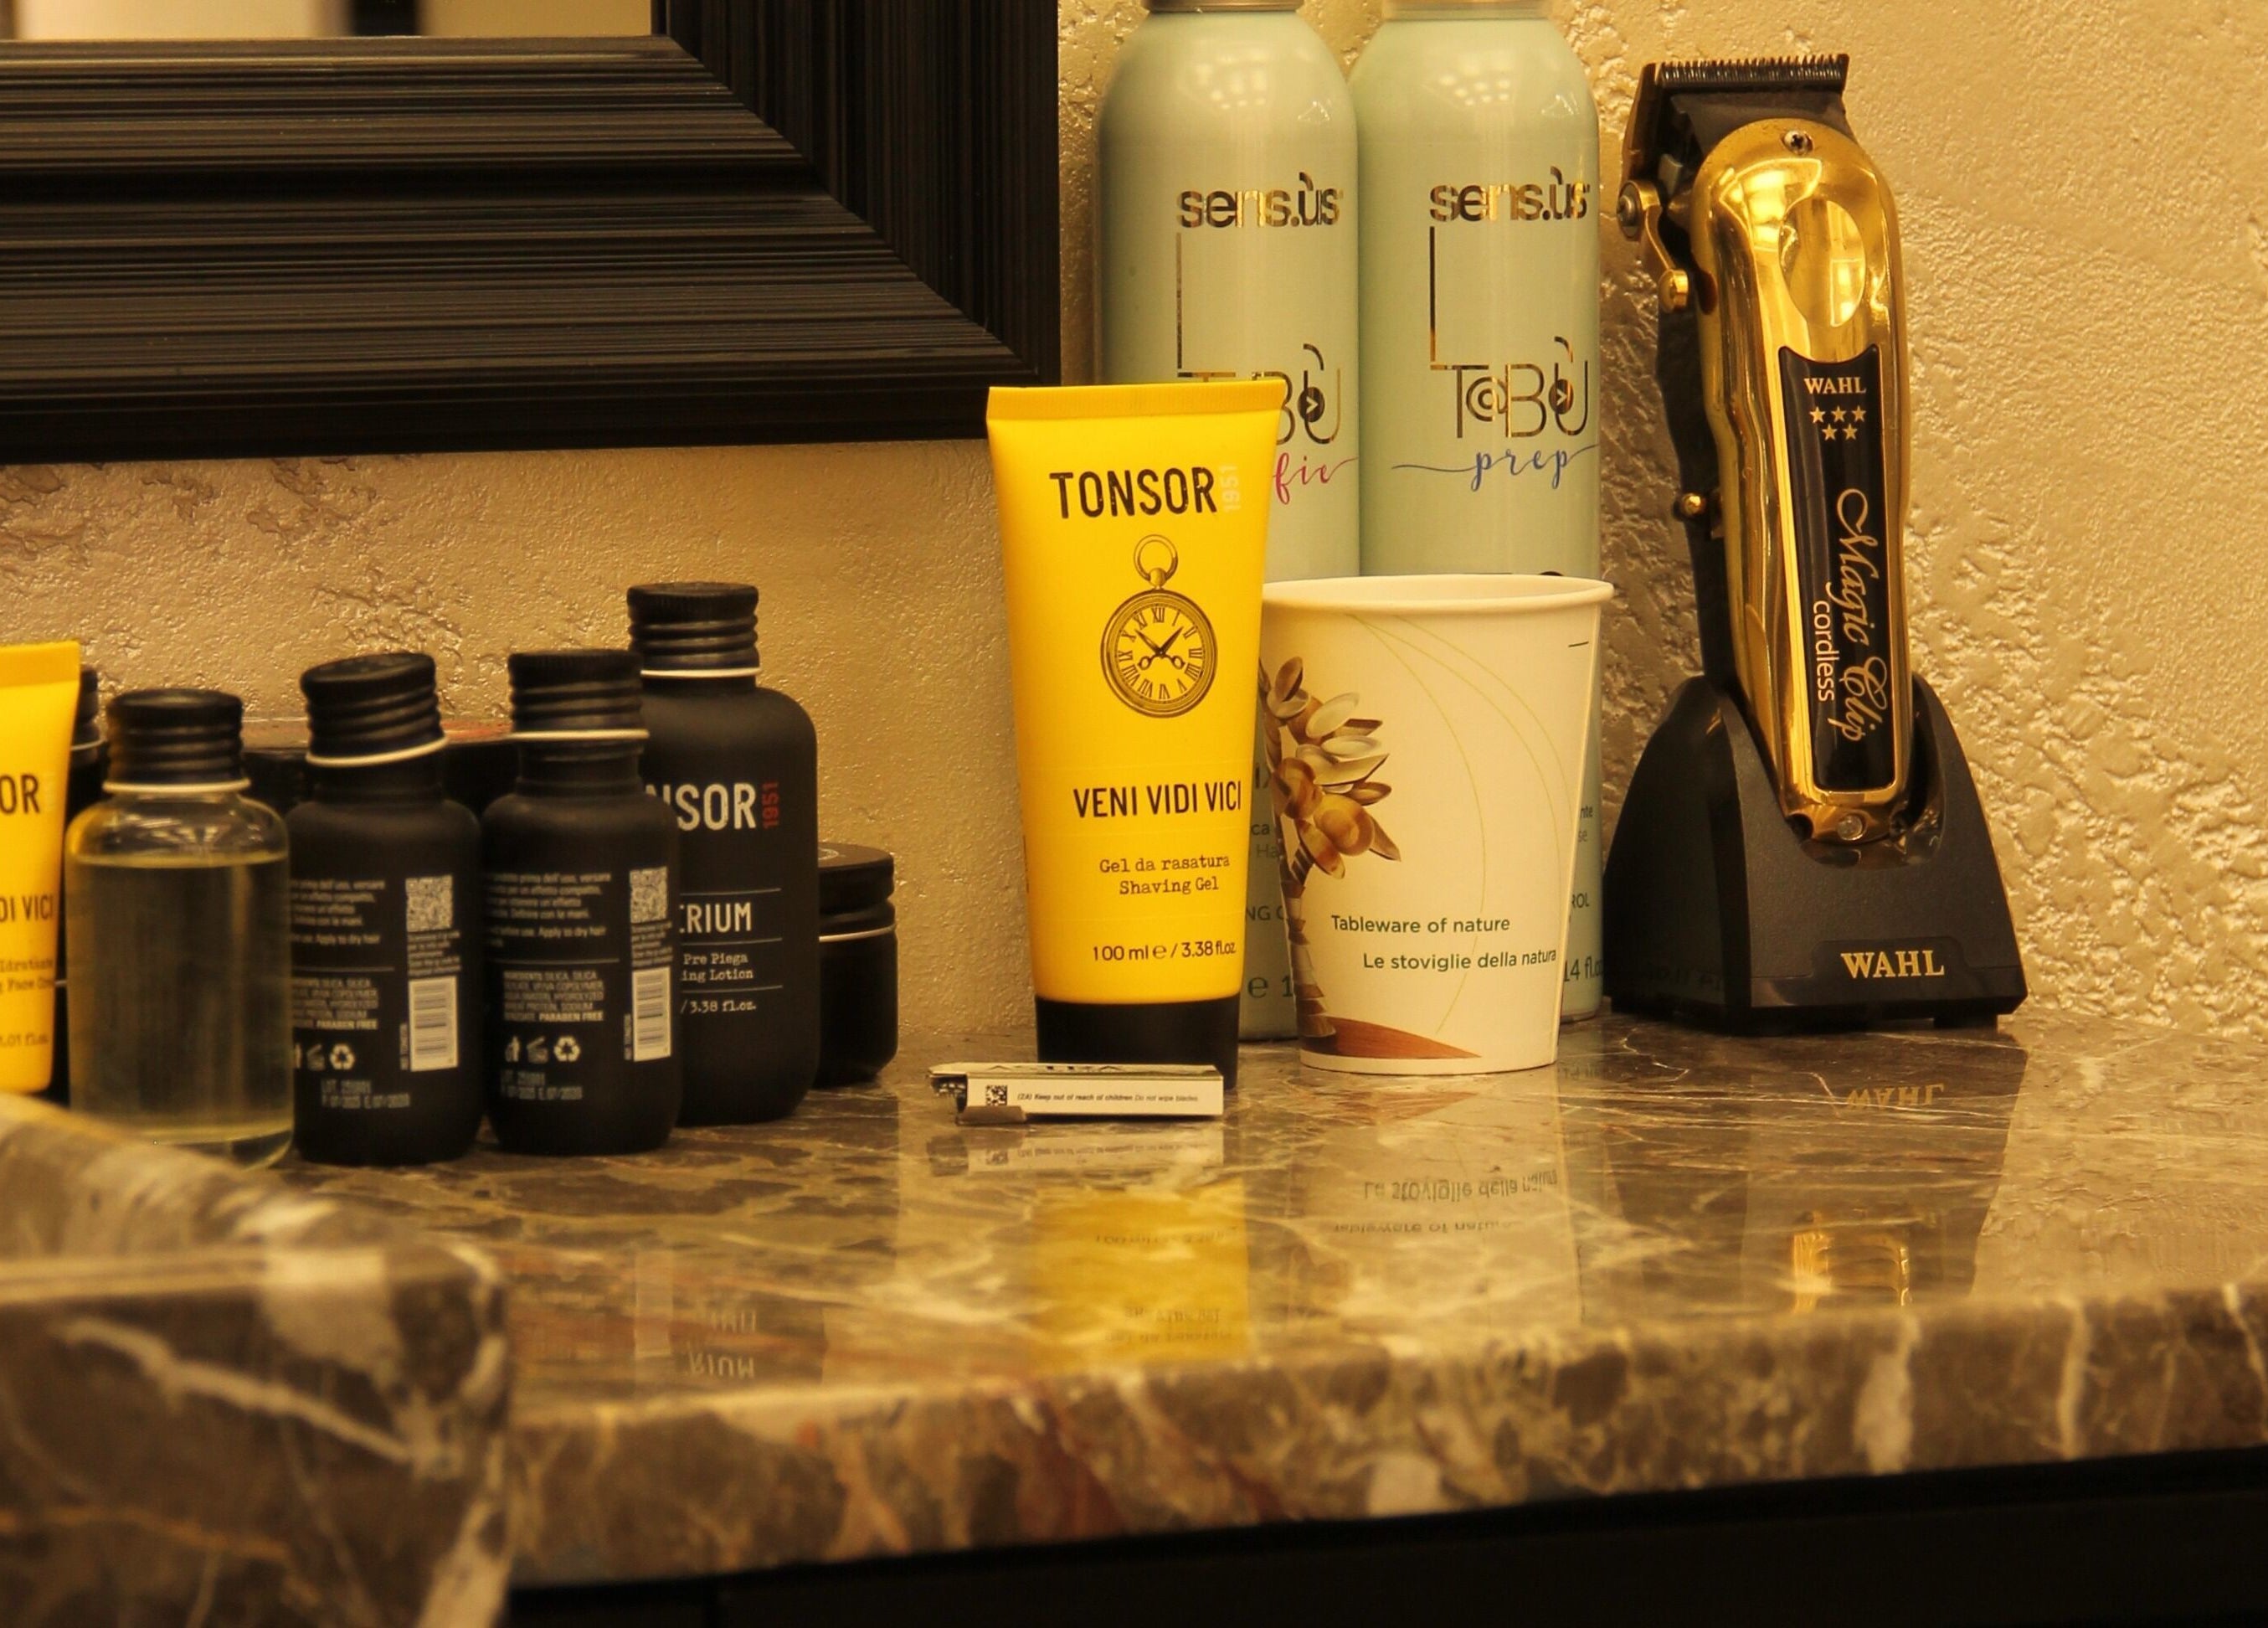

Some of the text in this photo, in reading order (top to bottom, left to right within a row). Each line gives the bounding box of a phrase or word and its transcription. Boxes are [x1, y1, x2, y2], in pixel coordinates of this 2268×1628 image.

[1804, 376, 1867, 395] WAHL
[1049, 464, 1242, 520] TONSOR 1951
[1826, 488, 1880, 646] Magic
[1813, 600, 1840, 702] cordless
[645, 782, 758, 832] SOR
[1072, 780, 1242, 818] VENI VIDI VICI
[1099, 853, 1231, 873] Gel da rasatura
[1119, 875, 1220, 895] Shaving Gel
[1330, 914, 1510, 933] Tableware of nature
[682, 951, 749, 966] Pre Piega
[1093, 945, 1125, 961] 100
[1129, 945, 1149, 961] ml
[1181, 940, 1214, 957] 3.38
[1362, 948, 1557, 972] Le stoviglie della natura
[710, 968, 755, 981] Lotion
[1840, 950, 1946, 979] WAHL
[690, 999, 718, 1014] 3.38
